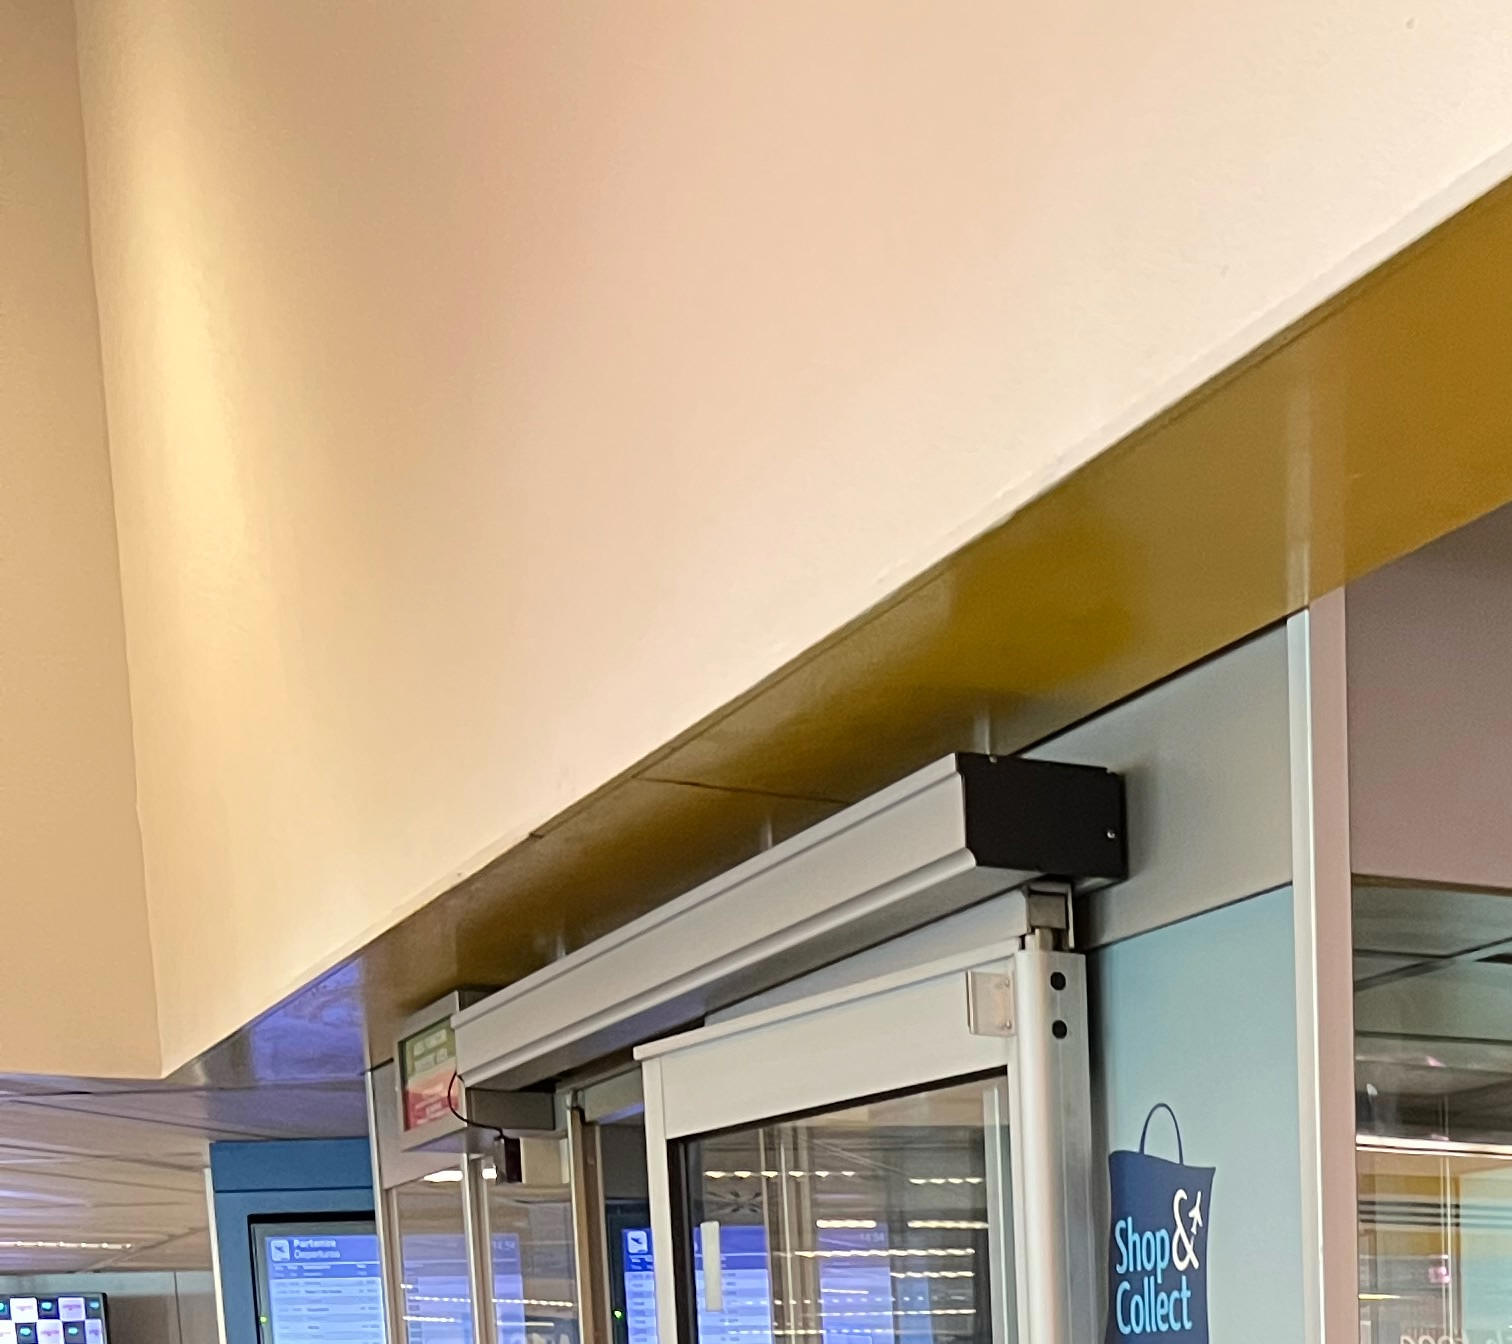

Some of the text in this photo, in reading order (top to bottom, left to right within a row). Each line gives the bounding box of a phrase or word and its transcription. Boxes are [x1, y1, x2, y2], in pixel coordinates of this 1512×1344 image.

[1115, 1188, 1201, 1284] Shop &
[1116, 1275, 1193, 1335] Collect
